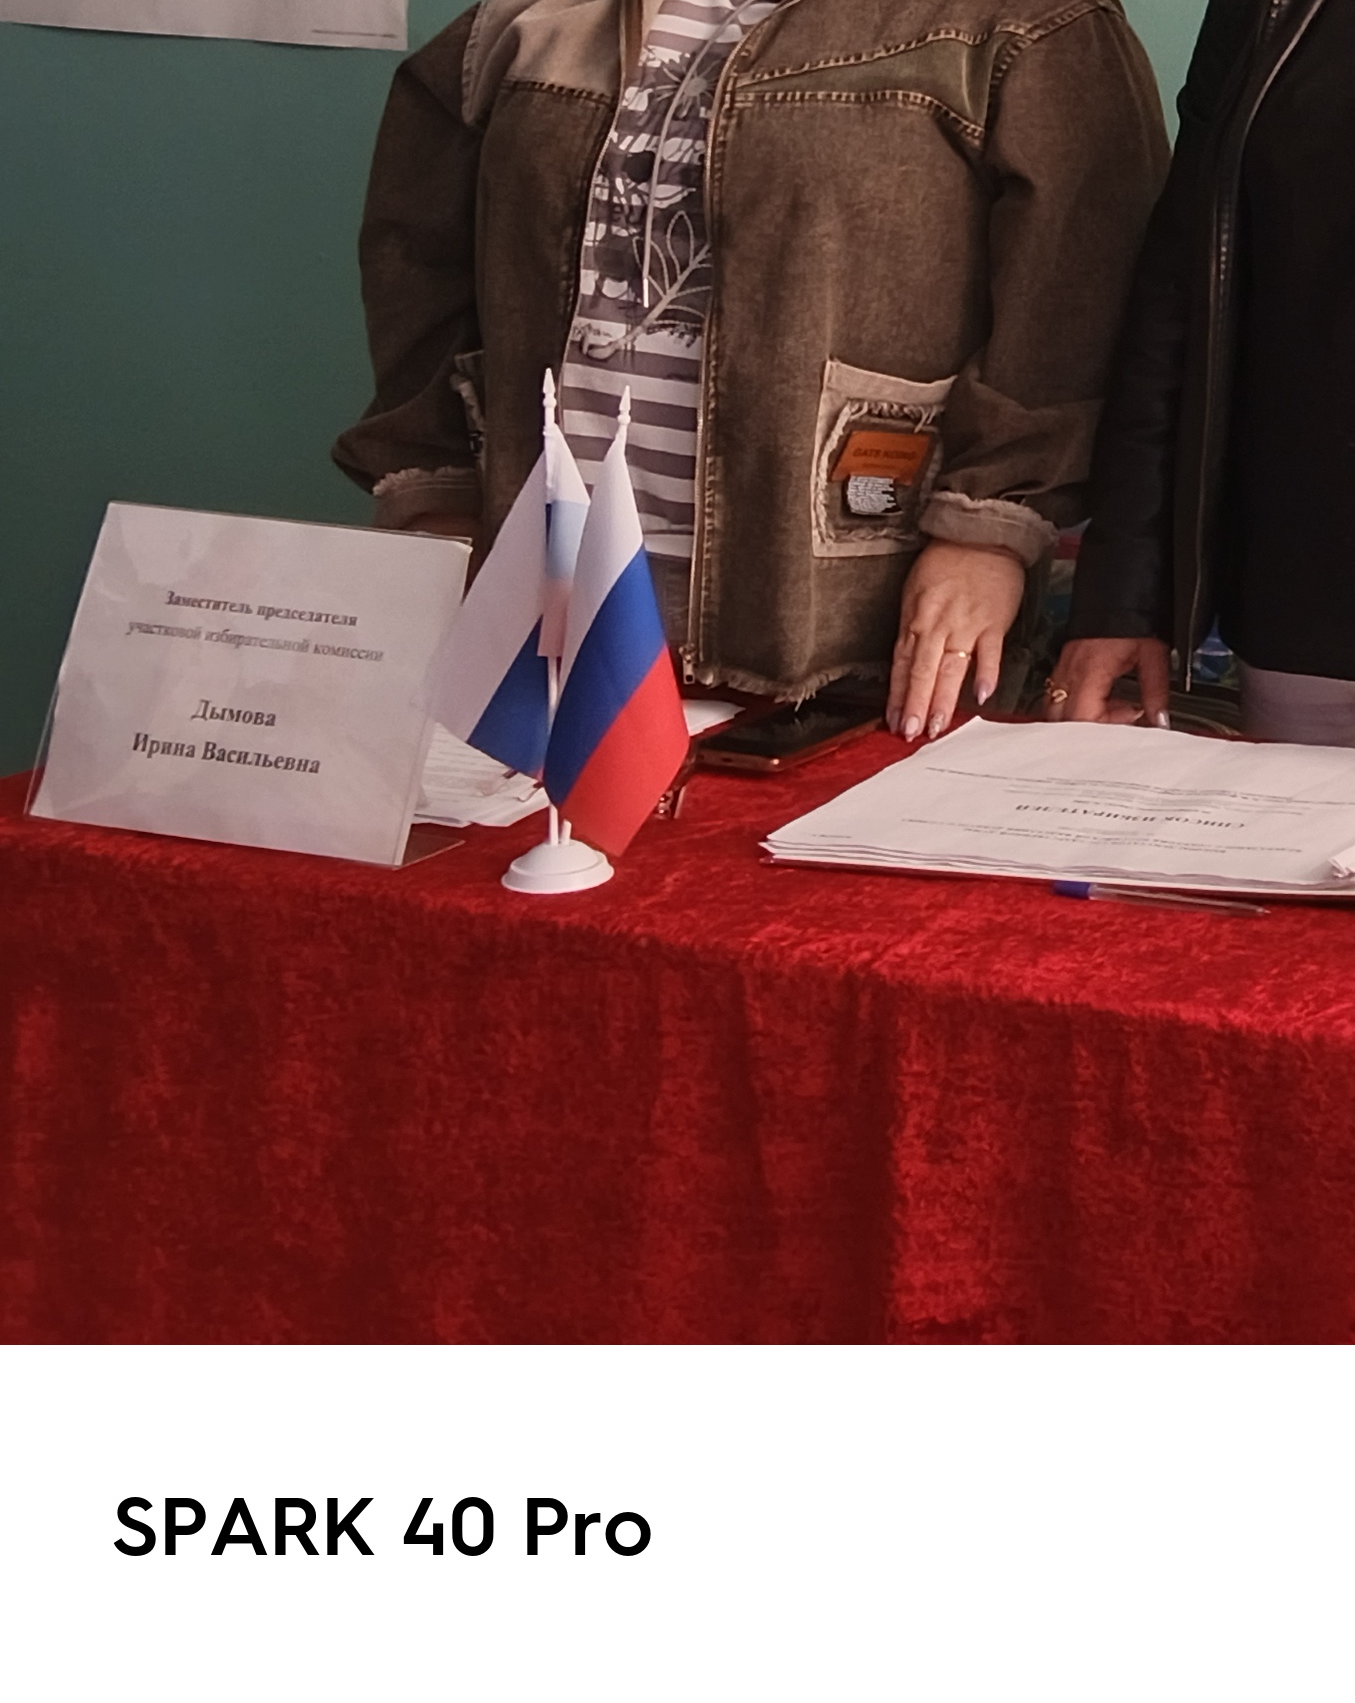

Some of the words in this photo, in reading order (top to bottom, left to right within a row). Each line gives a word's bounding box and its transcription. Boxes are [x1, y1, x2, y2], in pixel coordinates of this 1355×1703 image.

[165, 590, 253, 614] Заместитель
[257, 604, 358, 627] председателя
[125, 620, 202, 636] участковой
[204, 628, 309, 653] избирательной
[312, 643, 385, 662] комиссии
[190, 699, 277, 727] Дымова
[132, 732, 196, 759] Ирина
[200, 740, 321, 774] Васильевна
